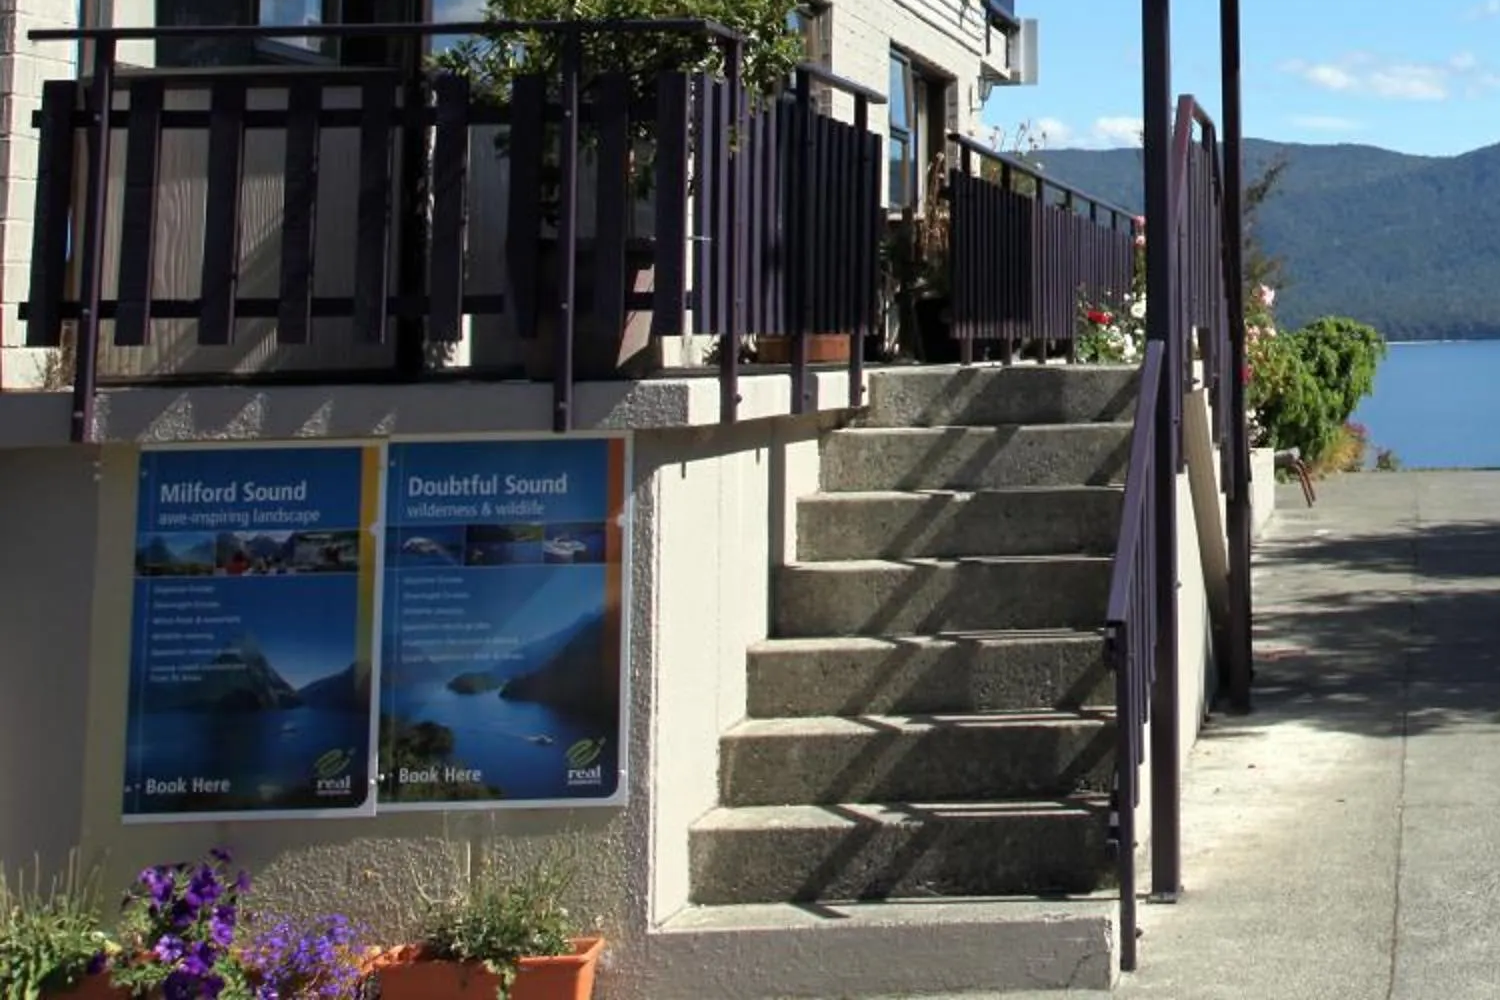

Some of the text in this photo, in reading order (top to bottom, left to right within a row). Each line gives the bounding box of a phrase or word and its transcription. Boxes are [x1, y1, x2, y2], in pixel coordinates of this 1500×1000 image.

[160, 481, 306, 503] Milford Sound
[408, 473, 567, 497] Doubtful Sound
[158, 507, 320, 528] awe-inspiring landscape
[407, 501, 477, 517] wilderness
[496, 500, 545, 516] wildlife
[317, 775, 351, 789] real
[399, 767, 482, 783] Book Here
[146, 777, 231, 795] Book Here
